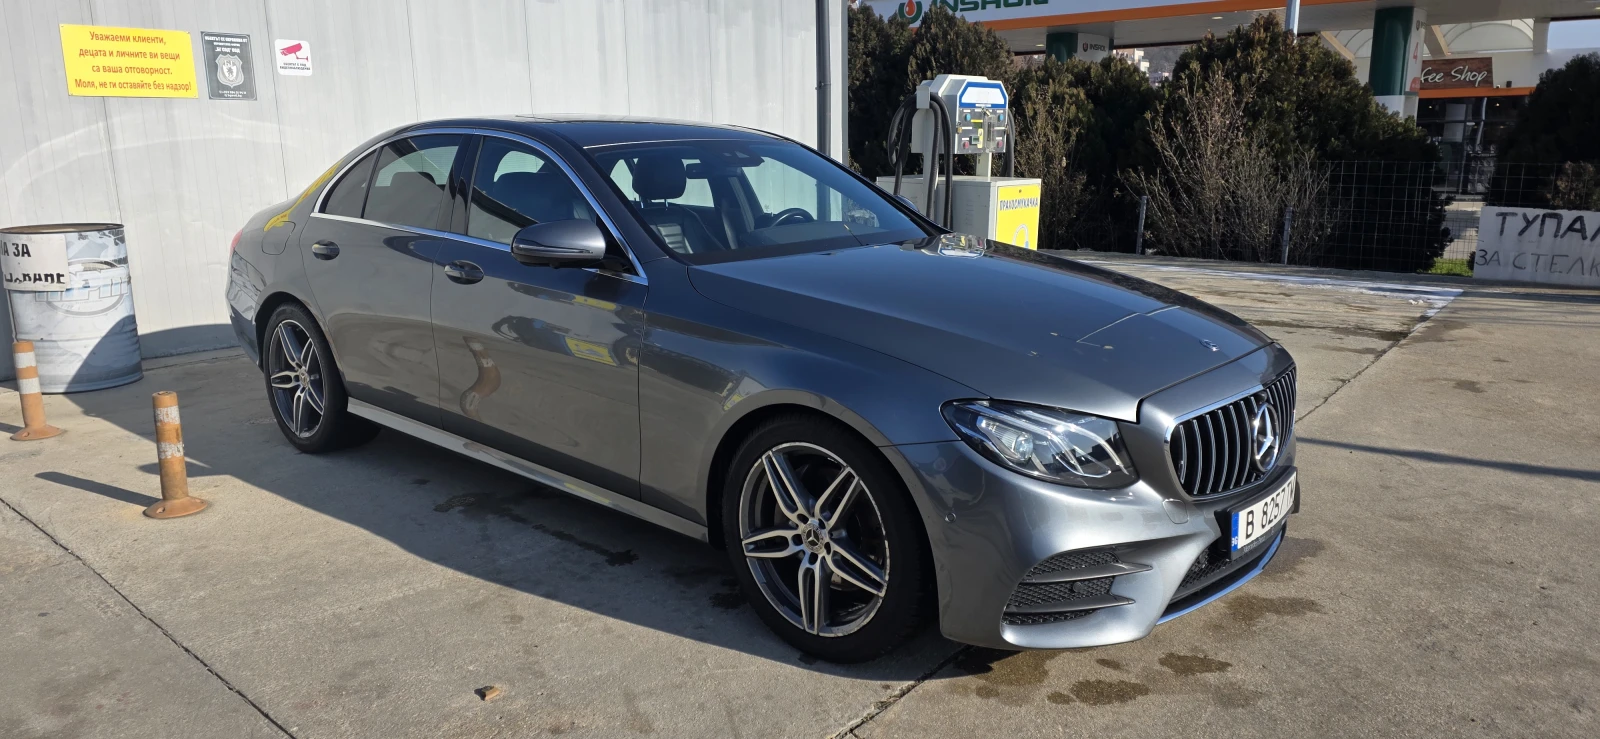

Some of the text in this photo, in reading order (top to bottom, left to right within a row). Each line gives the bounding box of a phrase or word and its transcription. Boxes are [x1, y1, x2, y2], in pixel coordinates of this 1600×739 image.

[89, 31, 167, 46] Уважаеми клиенти,
[79, 48, 107, 58] децата
[116, 50, 148, 59] личните
[161, 53, 180, 61] вещи
[1413, 41, 1419, 64] 4
[92, 65, 173, 76] са ваша отговорност.
[1451, 65, 1488, 87] Shop
[75, 79, 98, 90] Моля,
[99, 81, 107, 89] не
[118, 80, 151, 90] оставяйте
[153, 80, 165, 90] без
[166, 82, 192, 92] надзор!
[1476, 249, 1500, 266] ЗА
[1261, 487, 1286, 529] 8257
